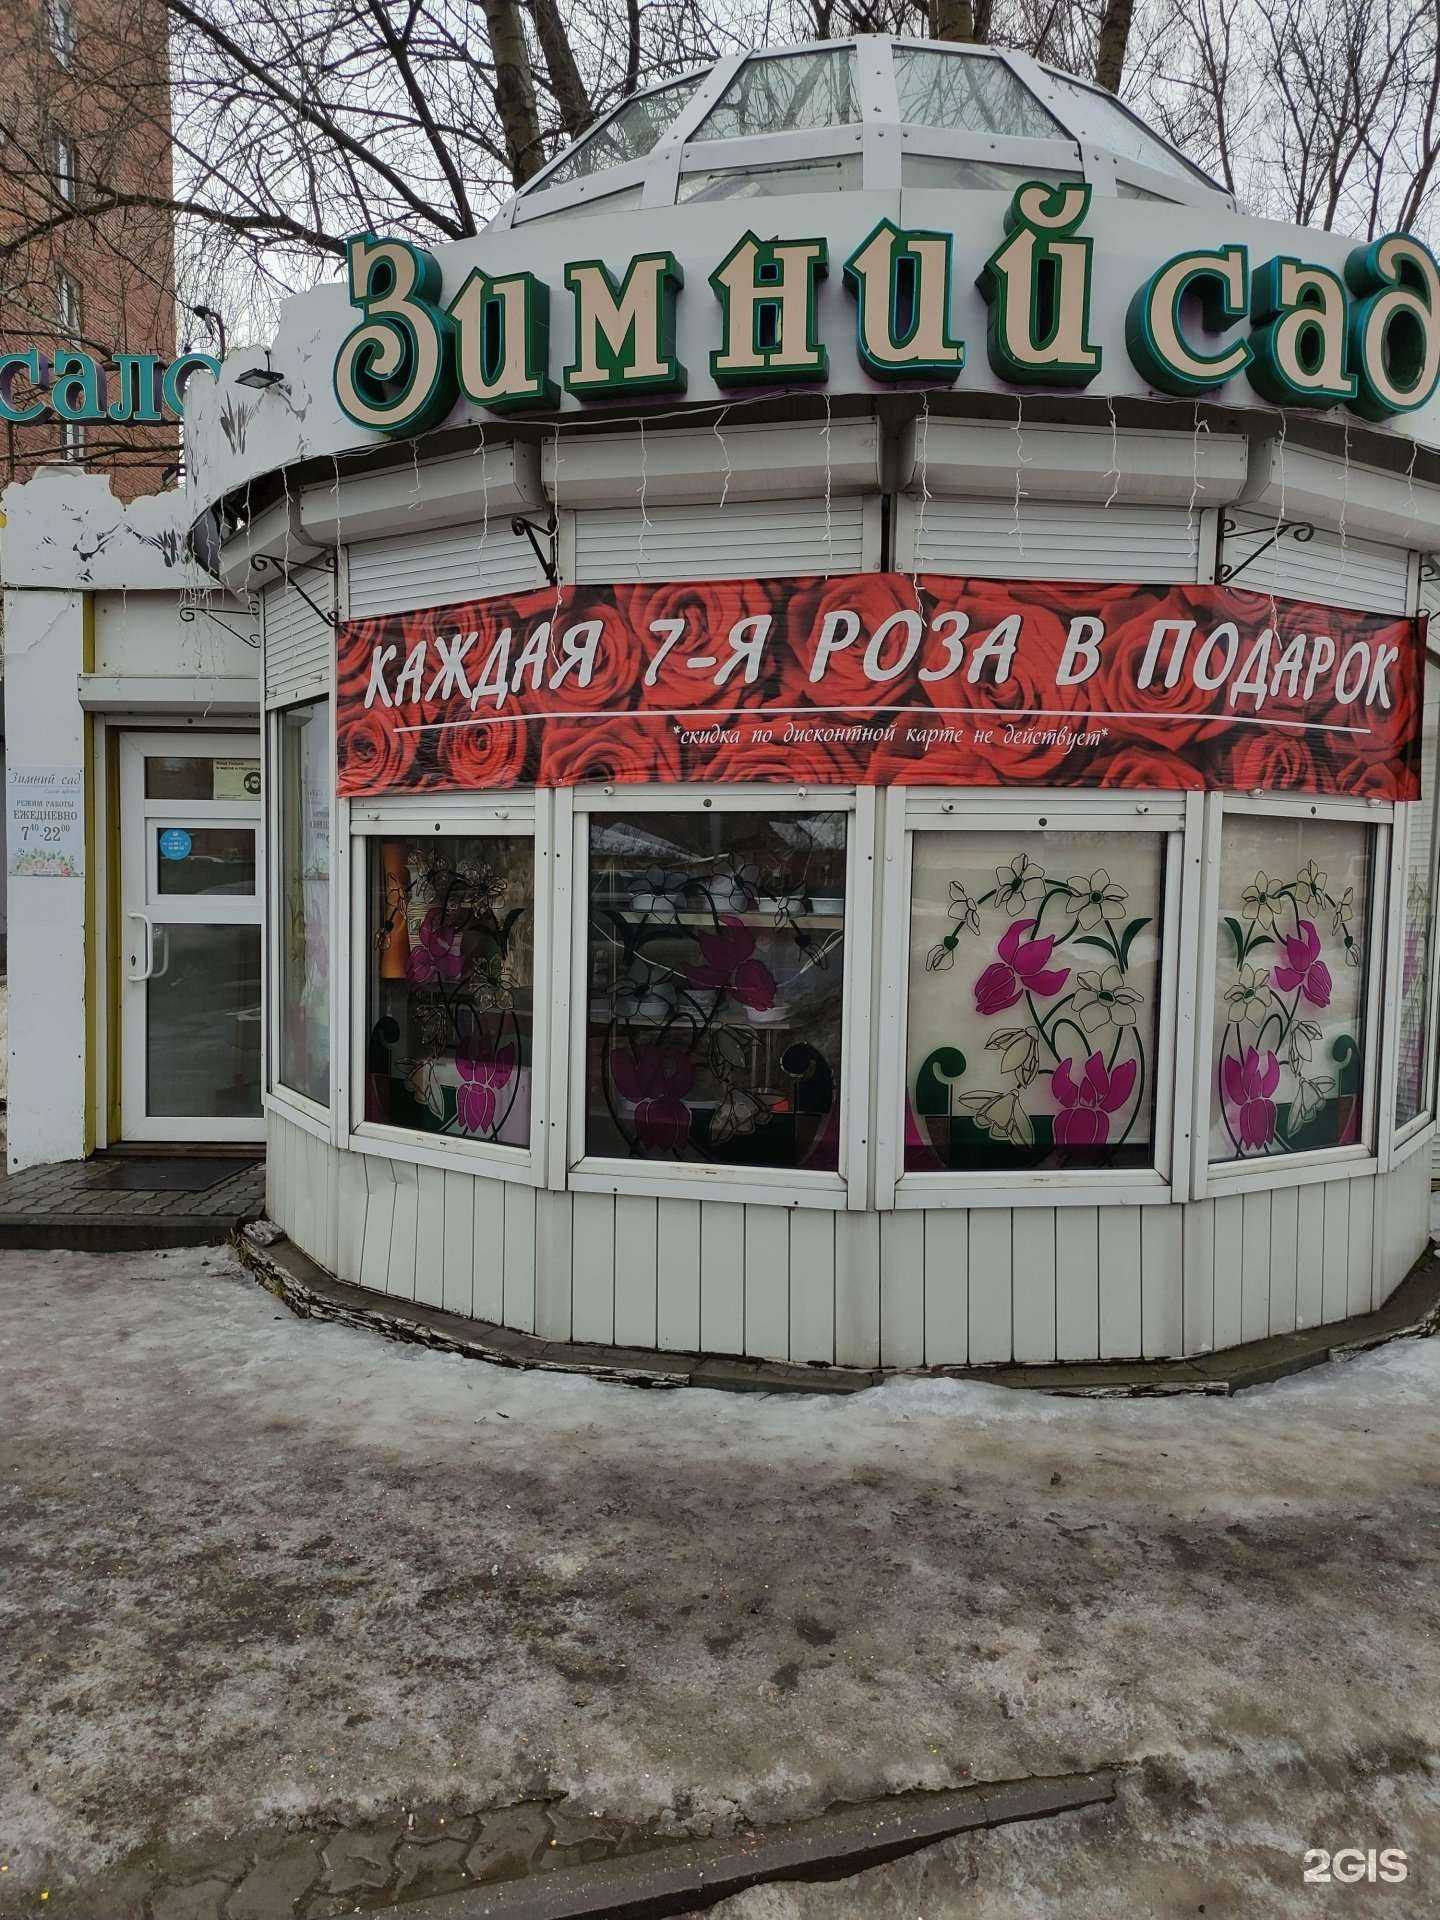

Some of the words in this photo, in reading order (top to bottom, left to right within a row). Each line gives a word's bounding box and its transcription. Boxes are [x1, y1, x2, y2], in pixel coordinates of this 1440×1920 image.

[333, 182, 1102, 434] Зимний
[1130, 232, 1440, 418] сад
[364, 619, 604, 710] КАЖДАЯ
[644, 614, 772, 687] 7-Я
[809, 609, 1022, 685] РОЗА
[1055, 616, 1106, 687] В
[1136, 620, 1400, 711] ПОДАРОК
[751, 729, 772, 744] по
[783, 722, 895, 745] дисконтной
[906, 727, 963, 750] карте
[974, 730, 994, 744] не
[9, 772, 55, 785] Зимний
[14, 810, 78, 821] ЕЖЕДНЕВНО
